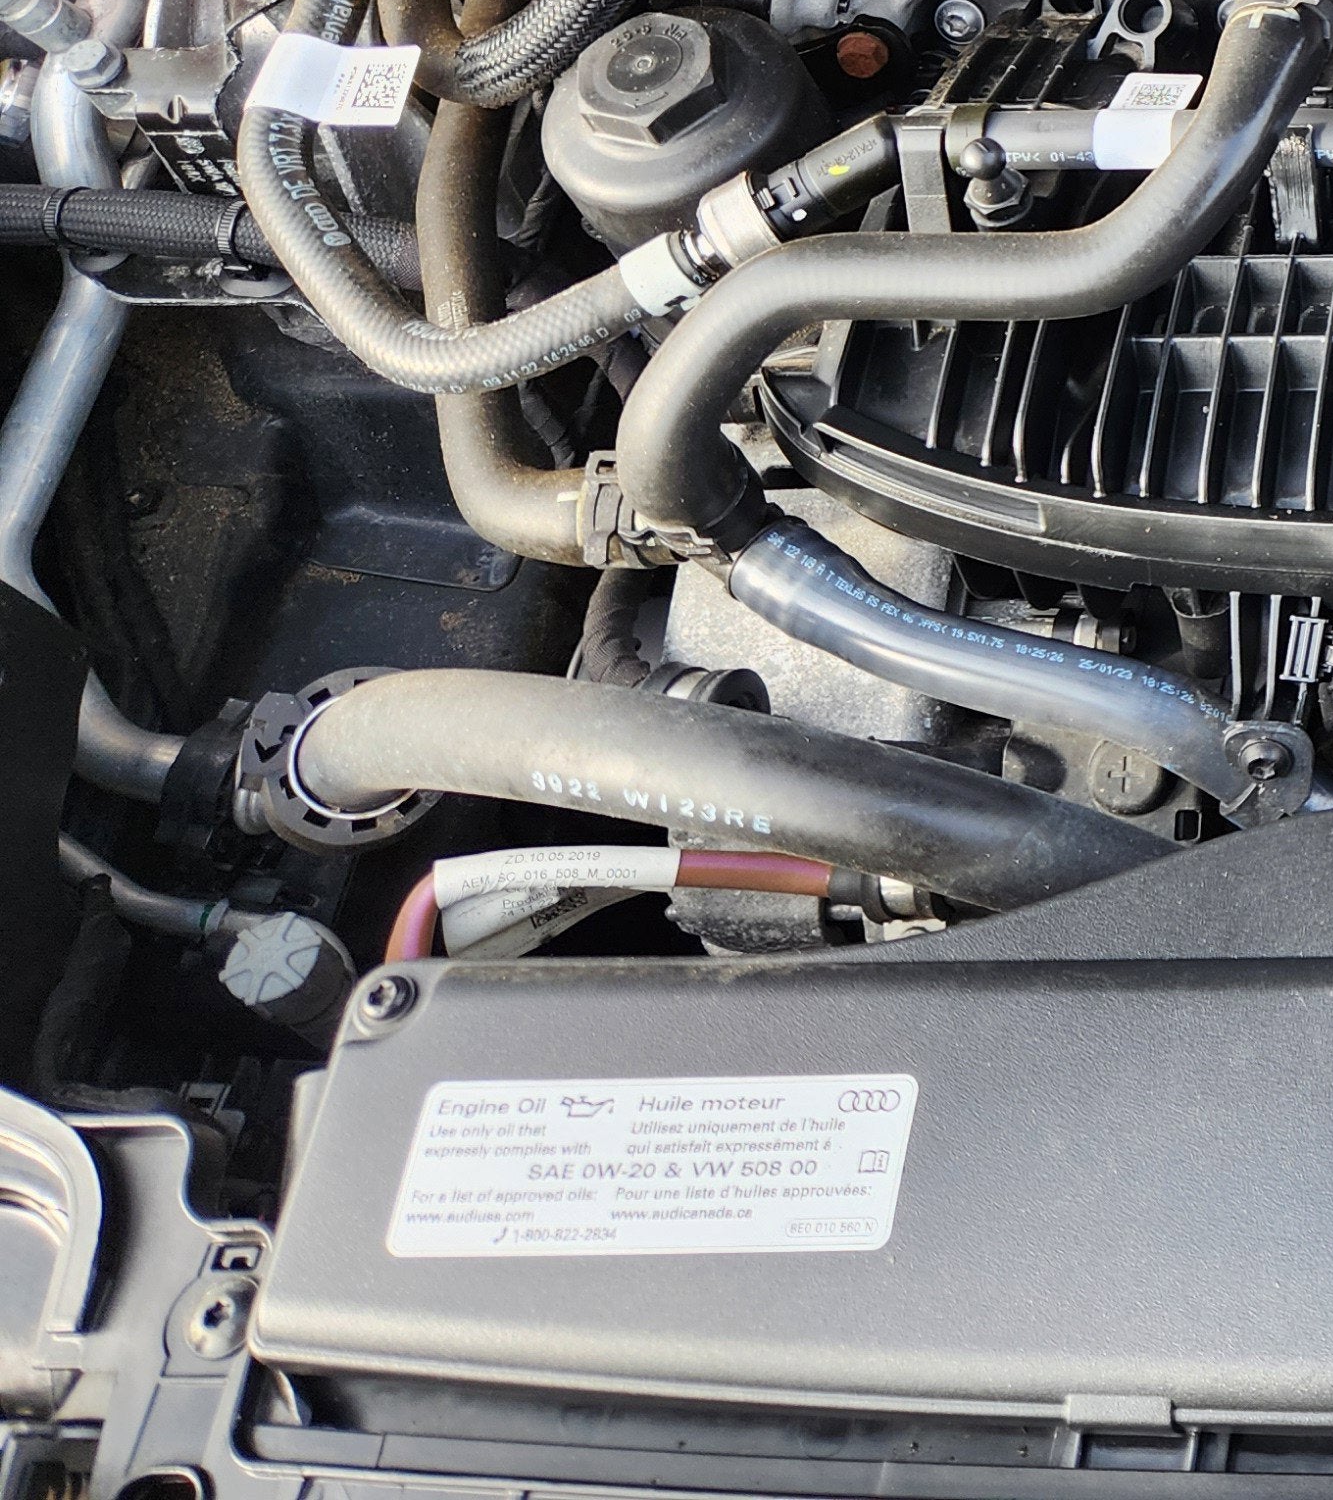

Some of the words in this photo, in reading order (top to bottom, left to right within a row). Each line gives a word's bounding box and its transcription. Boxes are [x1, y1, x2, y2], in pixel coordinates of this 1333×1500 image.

[269, 145, 306, 178] VRT
[1004, 151, 1041, 162] TPV<
[1051, 151, 1095, 162] 01-43
[784, 544, 801, 559] 122
[880, 602, 900, 617] PEX
[438, 1098, 509, 1119] Engine
[518, 1097, 547, 1114] Oil
[639, 1096, 693, 1112] Huile
[701, 1097, 786, 1111] moteur
[430, 1126, 456, 1138] Use
[462, 1124, 492, 1139] only
[497, 1124, 515, 1137] oil
[518, 1124, 546, 1137] that
[631, 1120, 683, 1135] Utilisez
[689, 1119, 775, 1137] uniquement
[780, 1119, 798, 1132] de
[424, 1143, 488, 1158] expressly
[494, 1142, 557, 1157] complies
[562, 1142, 592, 1156] with
[627, 1140, 650, 1156] qui
[655, 1140, 711, 1154] satisfait
[529, 1164, 575, 1180] SAE
[583, 1162, 656, 1180] 0W-20
[664, 1162, 682, 1178] &
[693, 1161, 734, 1177] VW
[741, 1160, 782, 1177] 508
[790, 1160, 817, 1176] 00
[412, 1190, 435, 1203] For
[450, 1189, 472, 1202] list
[477, 1188, 493, 1203] of
[496, 1188, 564, 1205] approved
[616, 1186, 648, 1201] Pour
[654, 1188, 681, 1200] une
[686, 1185, 714, 1199] liste
[406, 1210, 535, 1223] www.audiusa.com
[611, 1207, 752, 1221] www.audicanada.ca
